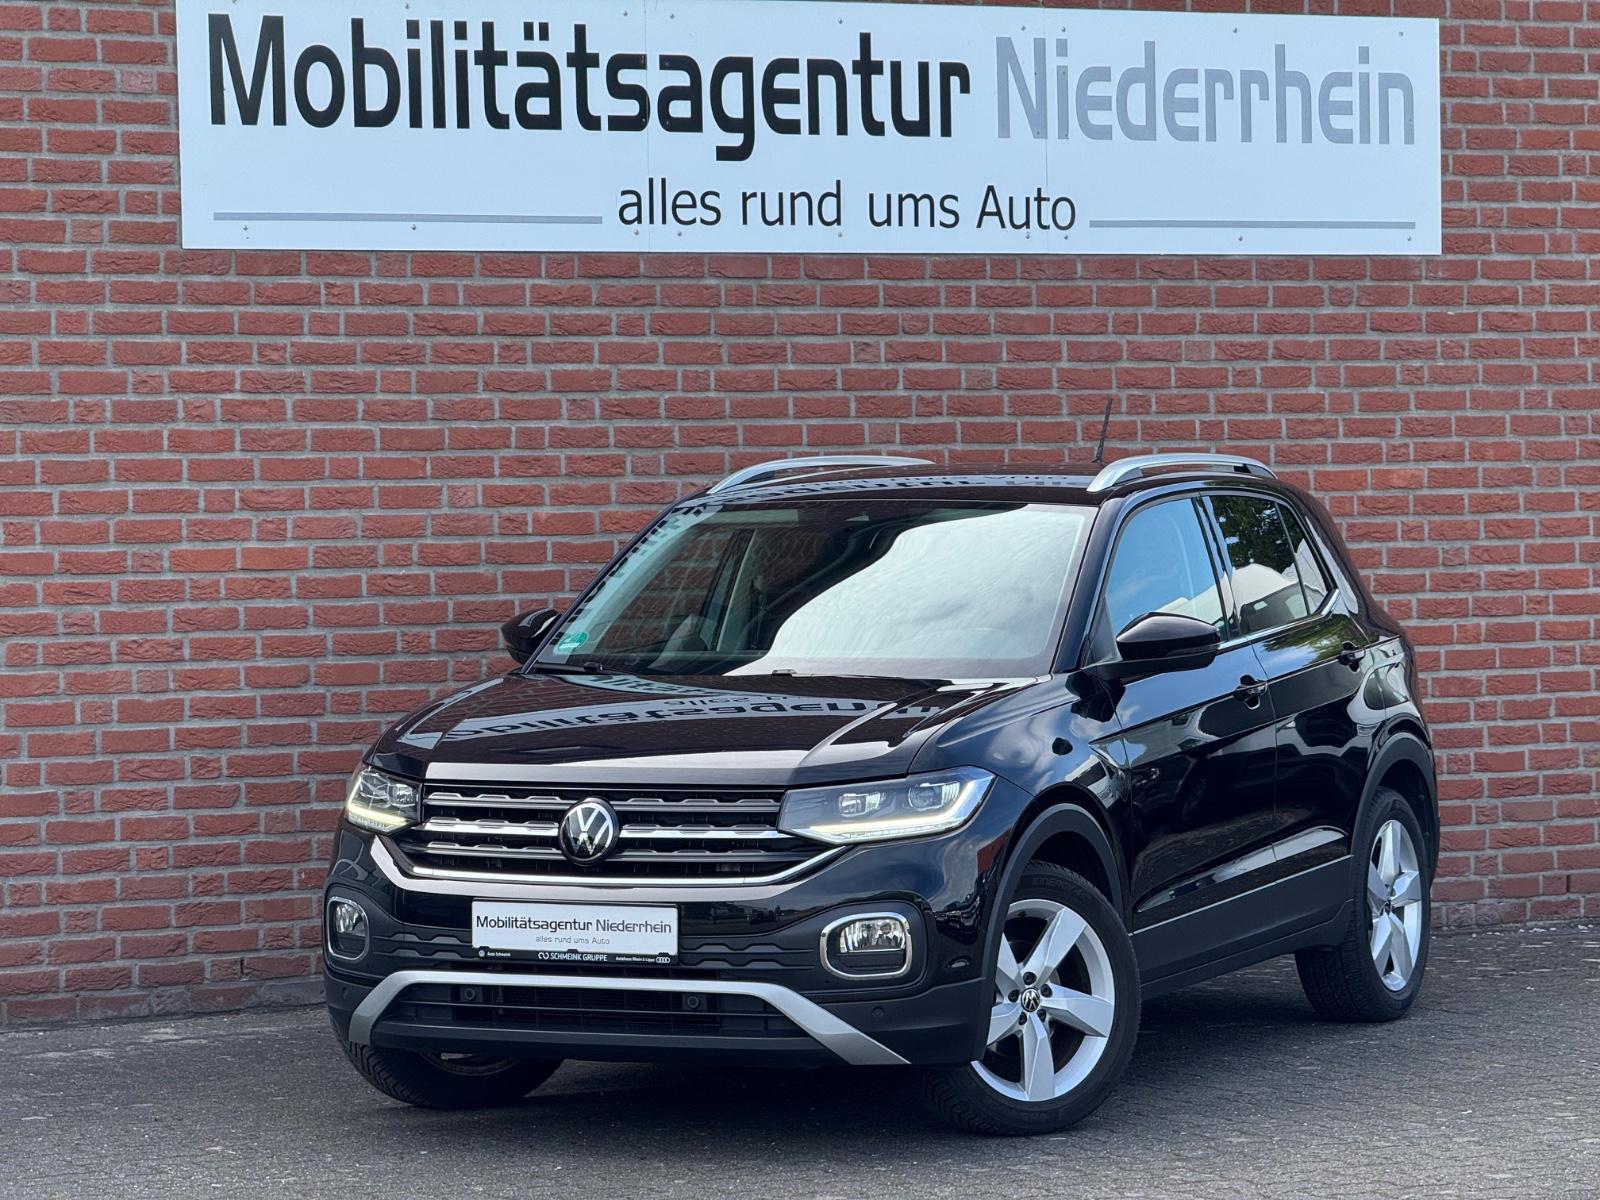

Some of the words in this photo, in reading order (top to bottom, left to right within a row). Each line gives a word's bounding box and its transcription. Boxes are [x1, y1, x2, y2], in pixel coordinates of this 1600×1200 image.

[208, 13, 970, 162] Mobilitätsagentur
[996, 36, 1415, 145] Niederrhein
[618, 178, 721, 226] alles
[741, 180, 842, 227] rund
[868, 191, 961, 230] ums
[976, 185, 1076, 231] Auto
[476, 915, 592, 933] Mobilitätsagentur
[596, 919, 672, 933] Niederrhein
[536, 935, 552, 943] alles
[554, 936, 571, 944] rund
[592, 936, 609, 945] Auto
[550, 952, 581, 961] SCHMEINK
[582, 953, 608, 962] GRUPPE
